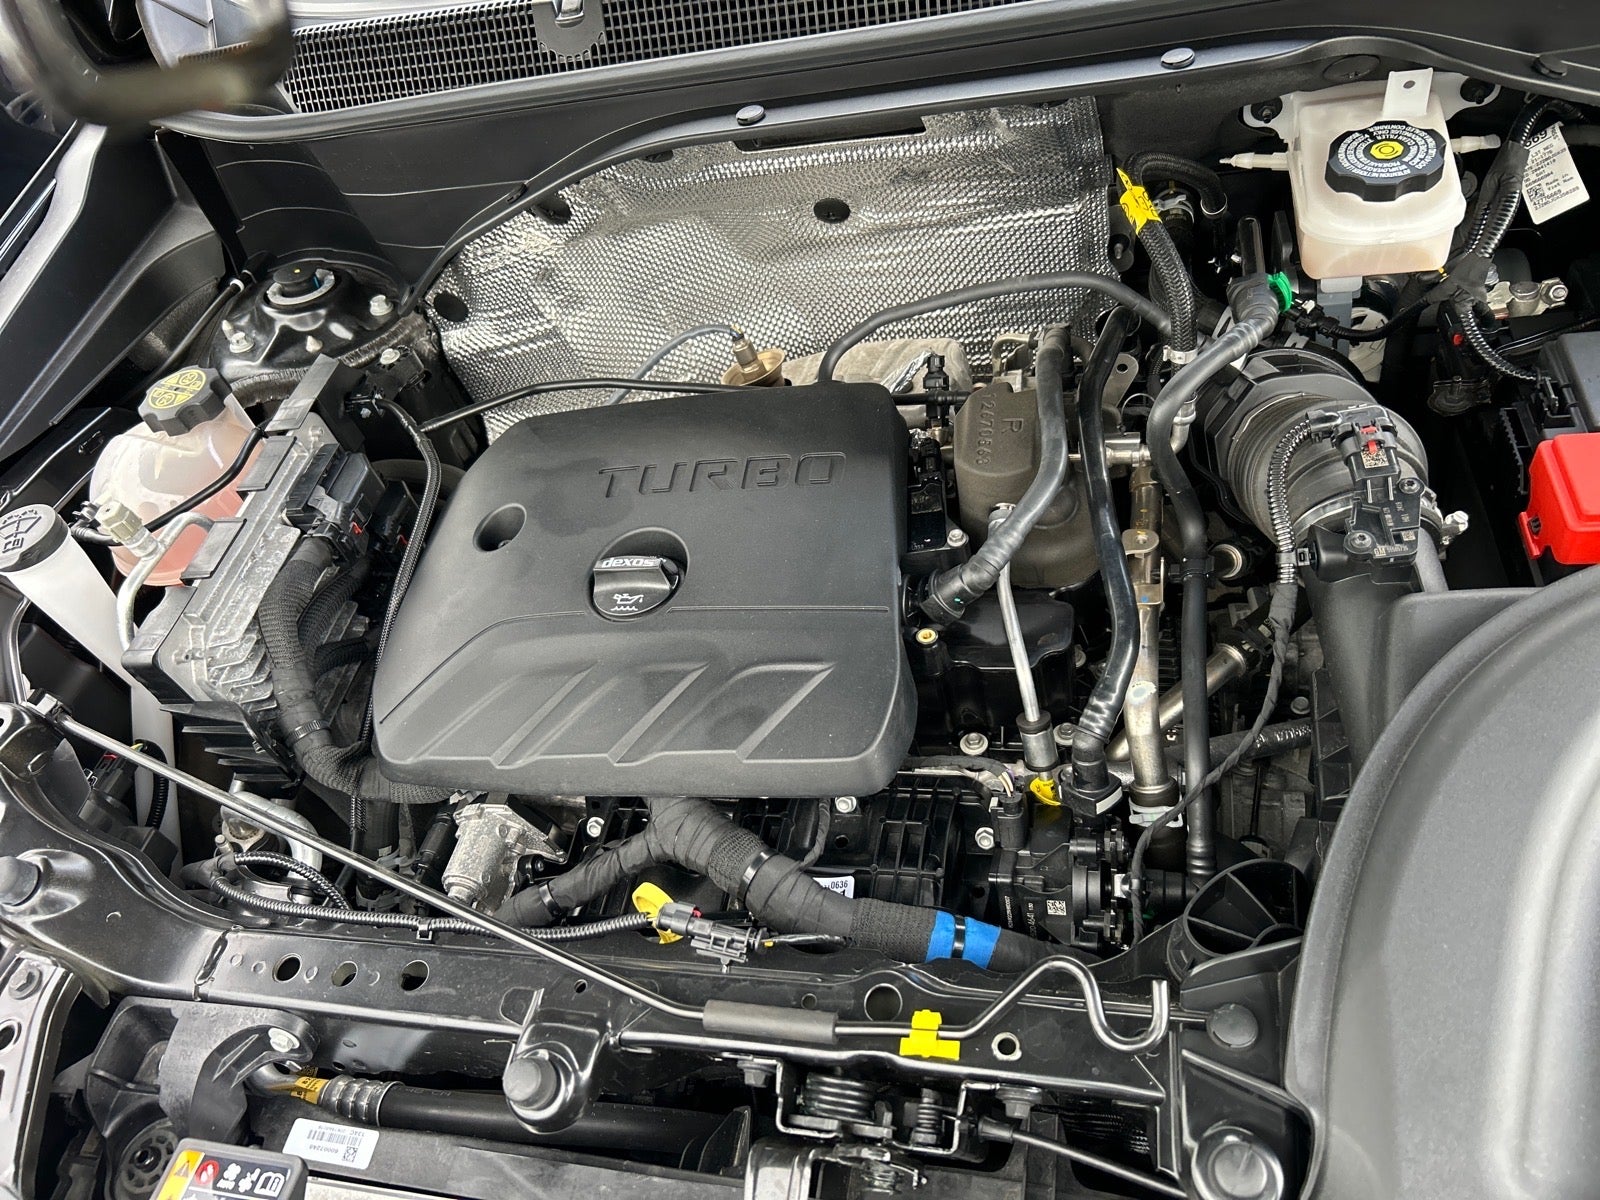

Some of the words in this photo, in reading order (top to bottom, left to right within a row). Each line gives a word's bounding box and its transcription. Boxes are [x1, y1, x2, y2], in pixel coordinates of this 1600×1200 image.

[1001, 417, 1024, 434] R
[599, 451, 847, 498] TURBO
[601, 557, 655, 568] dexos
[830, 880, 849, 889] 0636
